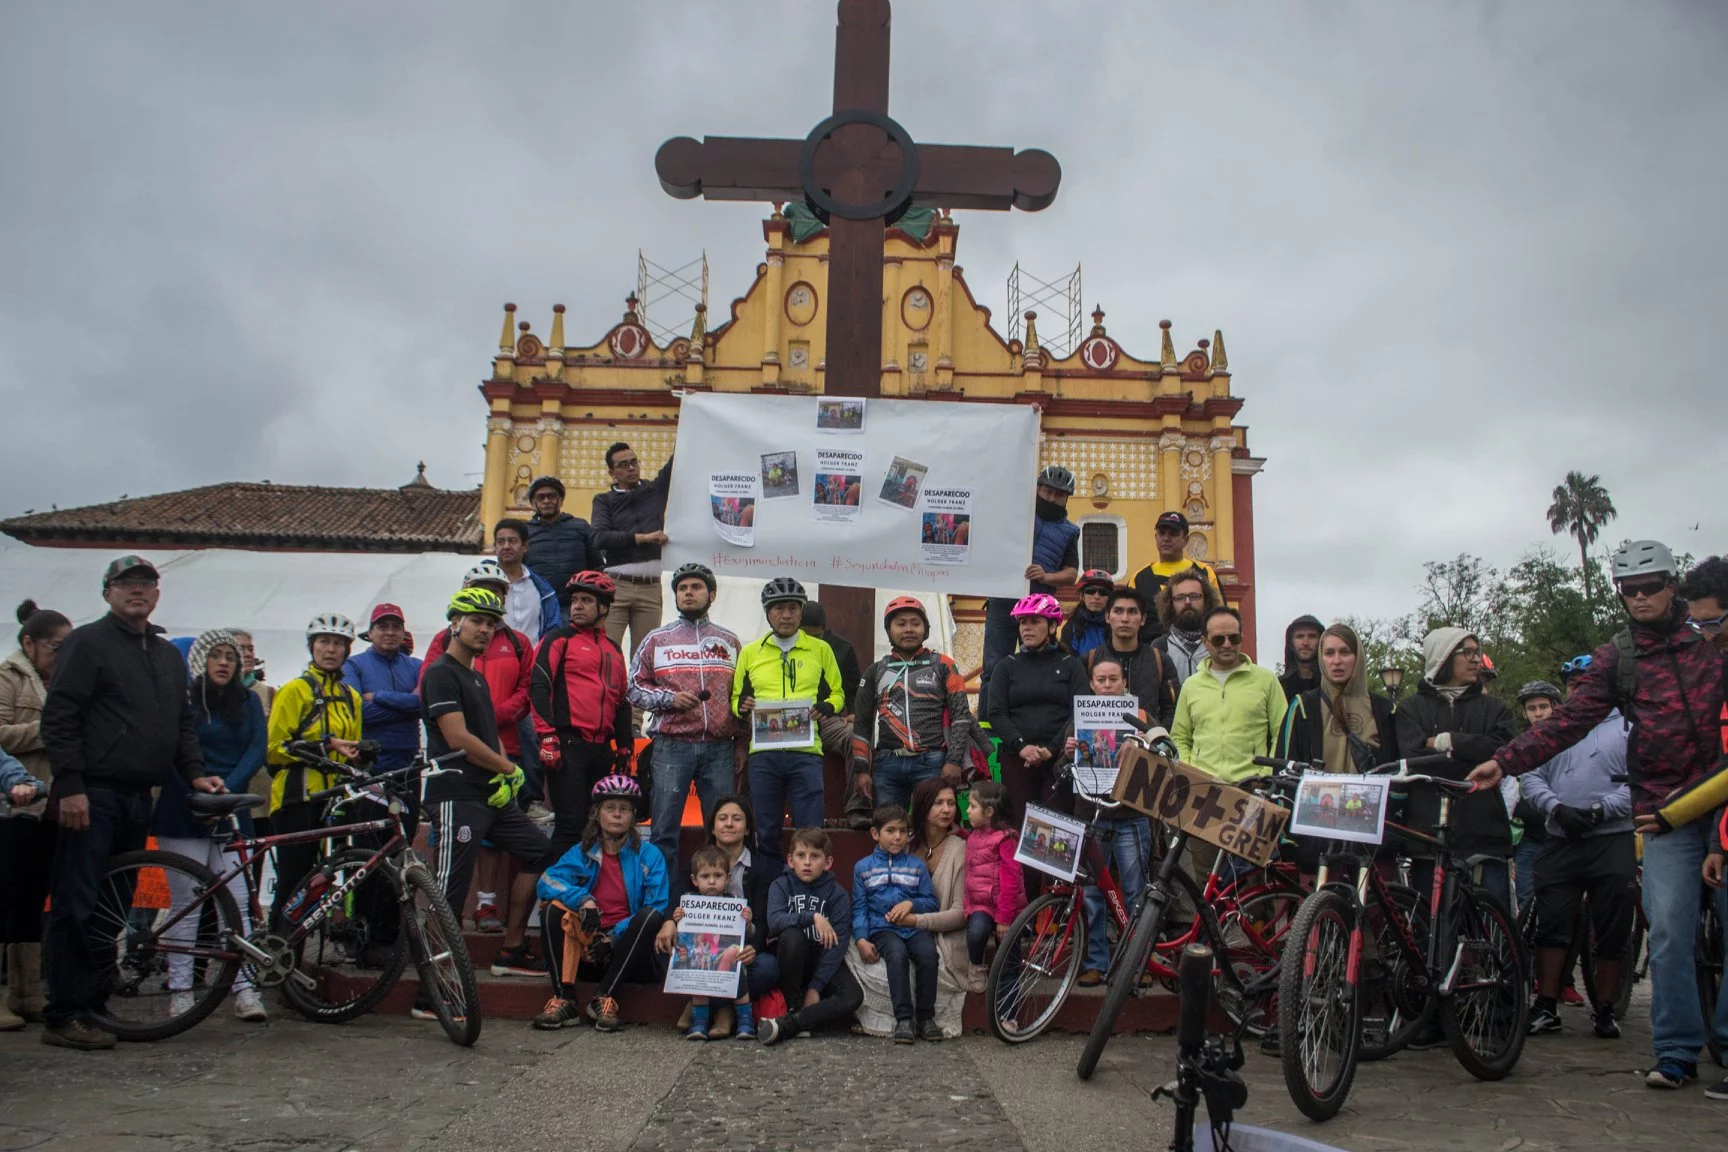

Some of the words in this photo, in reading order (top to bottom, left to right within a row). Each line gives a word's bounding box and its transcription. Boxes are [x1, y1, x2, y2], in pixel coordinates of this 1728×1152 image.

[817, 451, 863, 460] DESAPARECIDO
[711, 475, 756, 483] DESAPARECIDO
[924, 489, 971, 498] DESAPARECIDO
[1077, 699, 1135, 709] DESAPARECIDO
[1229, 798, 1284, 842] SAN
[1218, 822, 1269, 861] GRE
[303, 868, 367, 930] BENOTTO
[681, 899, 743, 912] DESAPARECIDO
[684, 911, 711, 920] HOLGER
[713, 914, 737, 922] FRANZ
